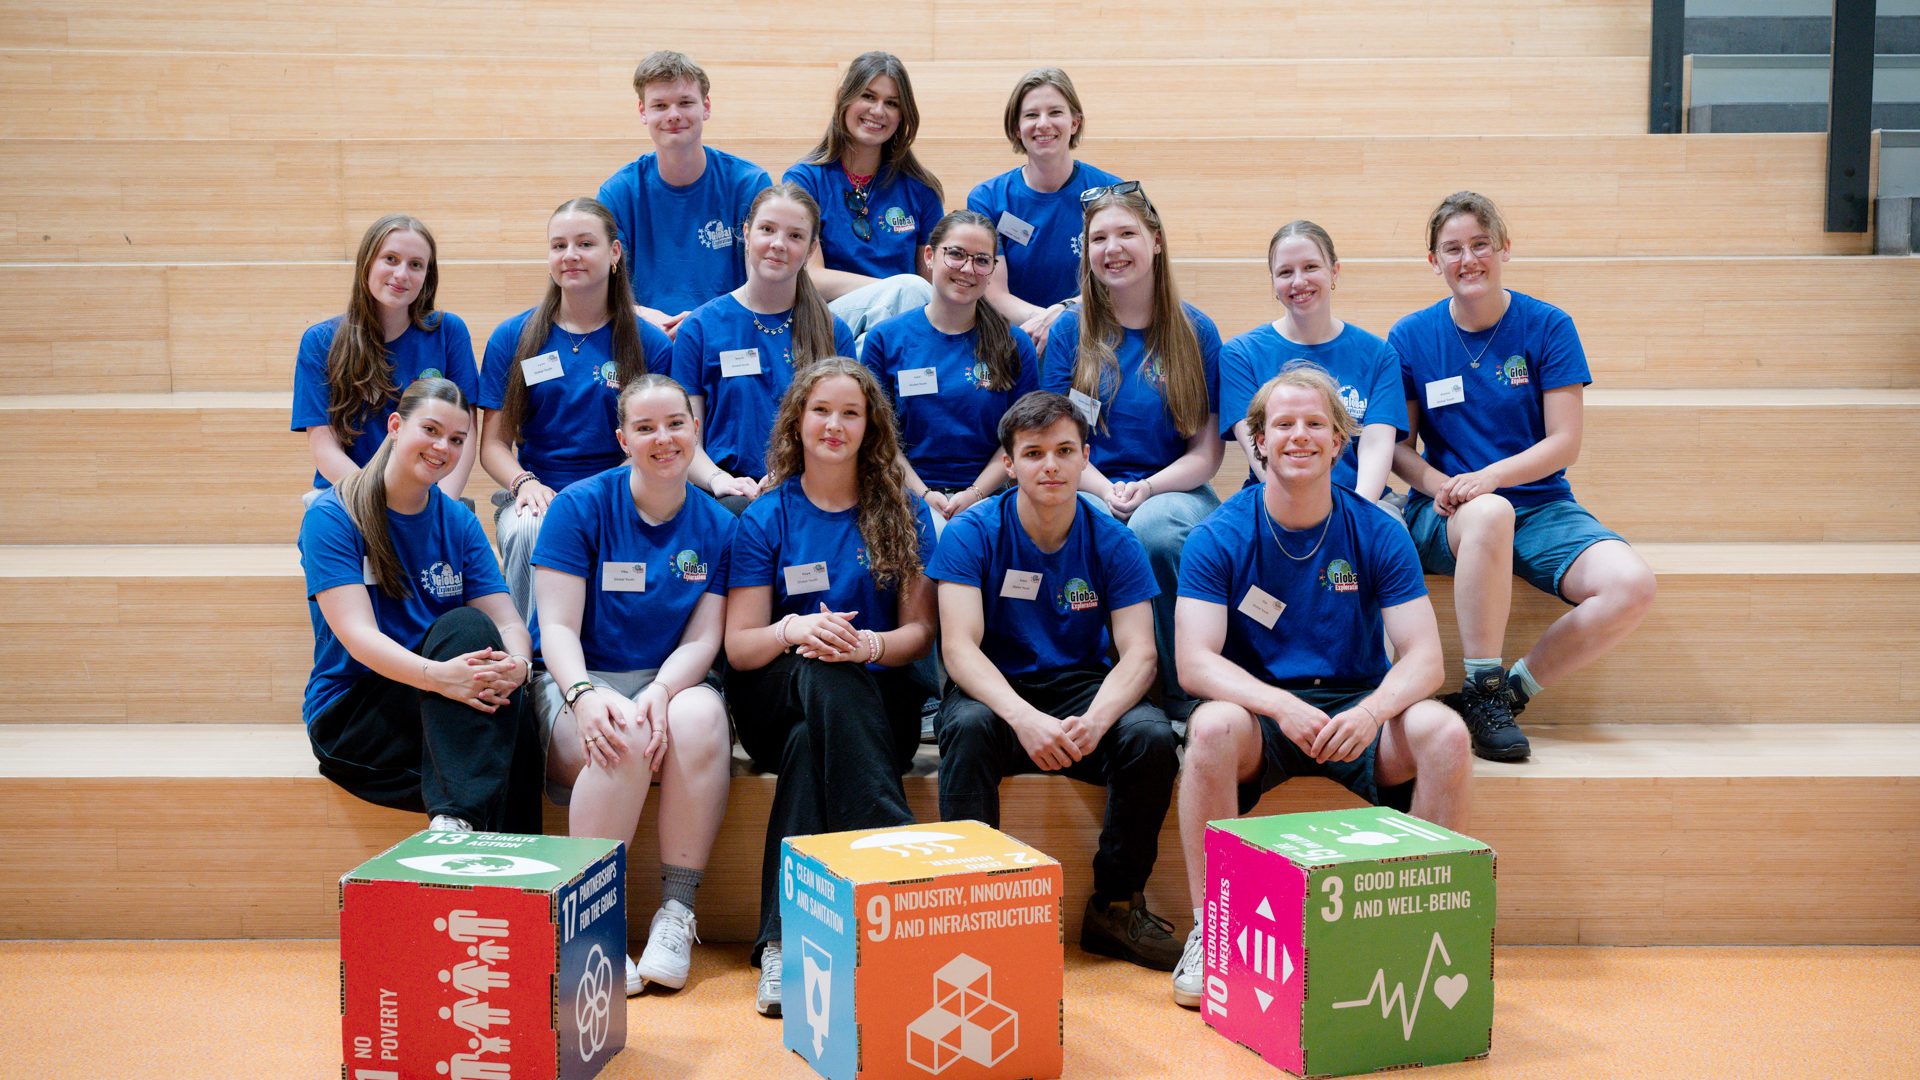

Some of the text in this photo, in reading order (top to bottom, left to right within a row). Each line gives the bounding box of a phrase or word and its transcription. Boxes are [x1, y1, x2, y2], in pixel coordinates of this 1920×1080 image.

[892, 216, 914, 226] Global
[1510, 366, 1527, 378] Glob
[435, 572, 462, 587] Global
[684, 561, 708, 574] Global
[1334, 572, 1358, 584] Globa
[422, 832, 470, 845] 13
[466, 840, 522, 848] ACTION
[476, 834, 538, 843] CLIMATE
[1292, 848, 1347, 861] 15
[1003, 852, 1039, 864] 2
[580, 861, 617, 905] PARTNERSHIPS
[784, 855, 794, 900] 6
[796, 862, 835, 903] CLEAN WATER
[894, 877, 1052, 912] INDUSTRY, INNOVATION
[1354, 865, 1451, 892] GOOD HEALTH
[580, 886, 618, 932] FOR THE GOALS
[796, 888, 844, 936] AND SANITATION
[1321, 876, 1344, 922] 3
[1353, 890, 1471, 919] AND WELL-BEING
[562, 890, 577, 944] 17
[866, 894, 891, 942] 9
[894, 904, 1052, 940] AND INFRASTRUCTURE
[1219, 878, 1230, 976] INEQUALITIES
[1207, 900, 1218, 970] REDUCED
[1207, 974, 1228, 1018] 10
[380, 988, 398, 1060] POVERTY
[354, 1036, 372, 1058] NO
